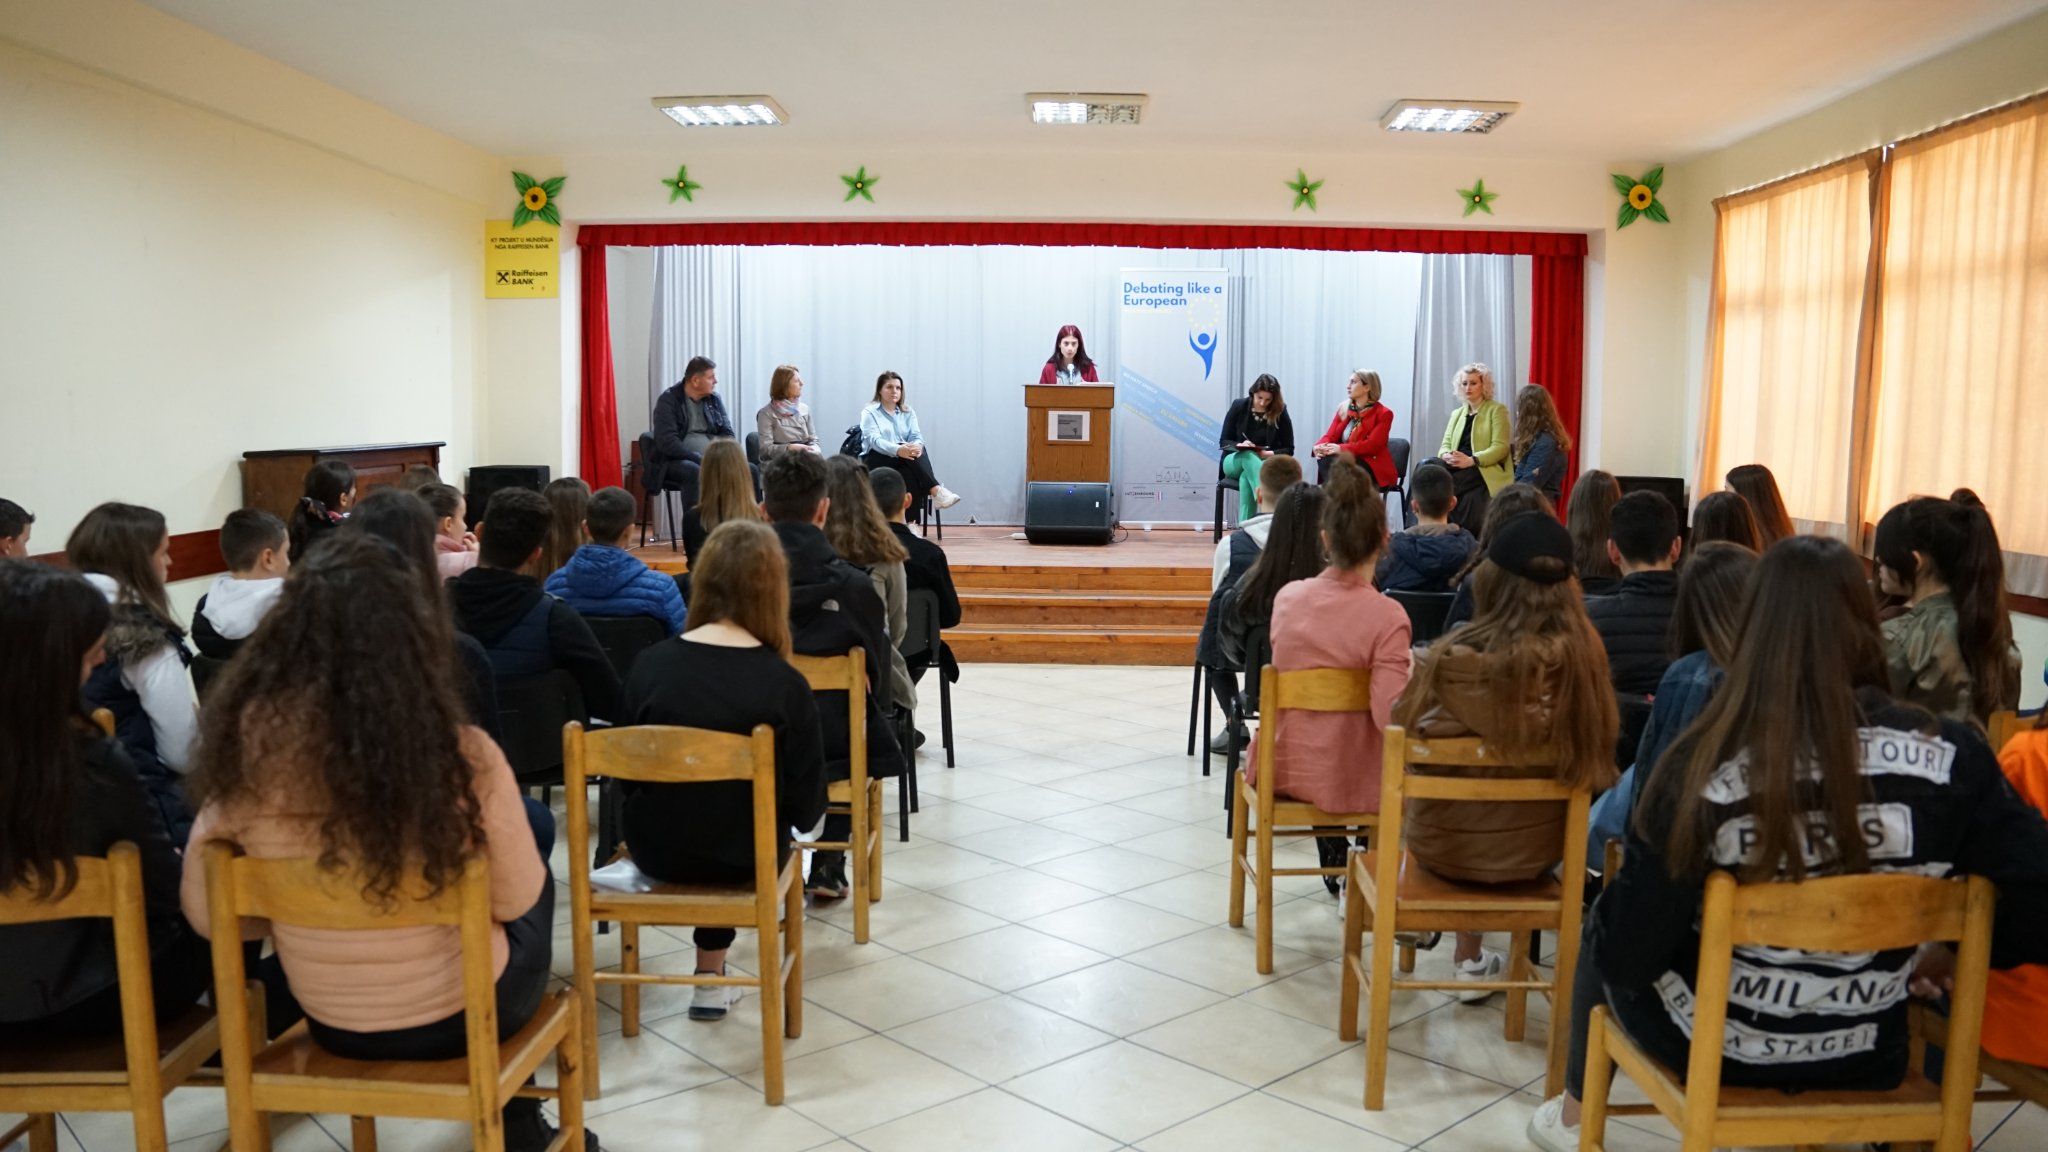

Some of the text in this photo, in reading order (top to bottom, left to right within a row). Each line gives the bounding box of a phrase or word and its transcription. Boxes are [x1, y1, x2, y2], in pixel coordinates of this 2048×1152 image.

[1123, 282, 1223, 297] Debating like a
[1123, 295, 1188, 309] European
[1861, 739, 1936, 772] TOUR
[1738, 817, 1885, 856] PRS
[1761, 1031, 1855, 1057] STAGE
